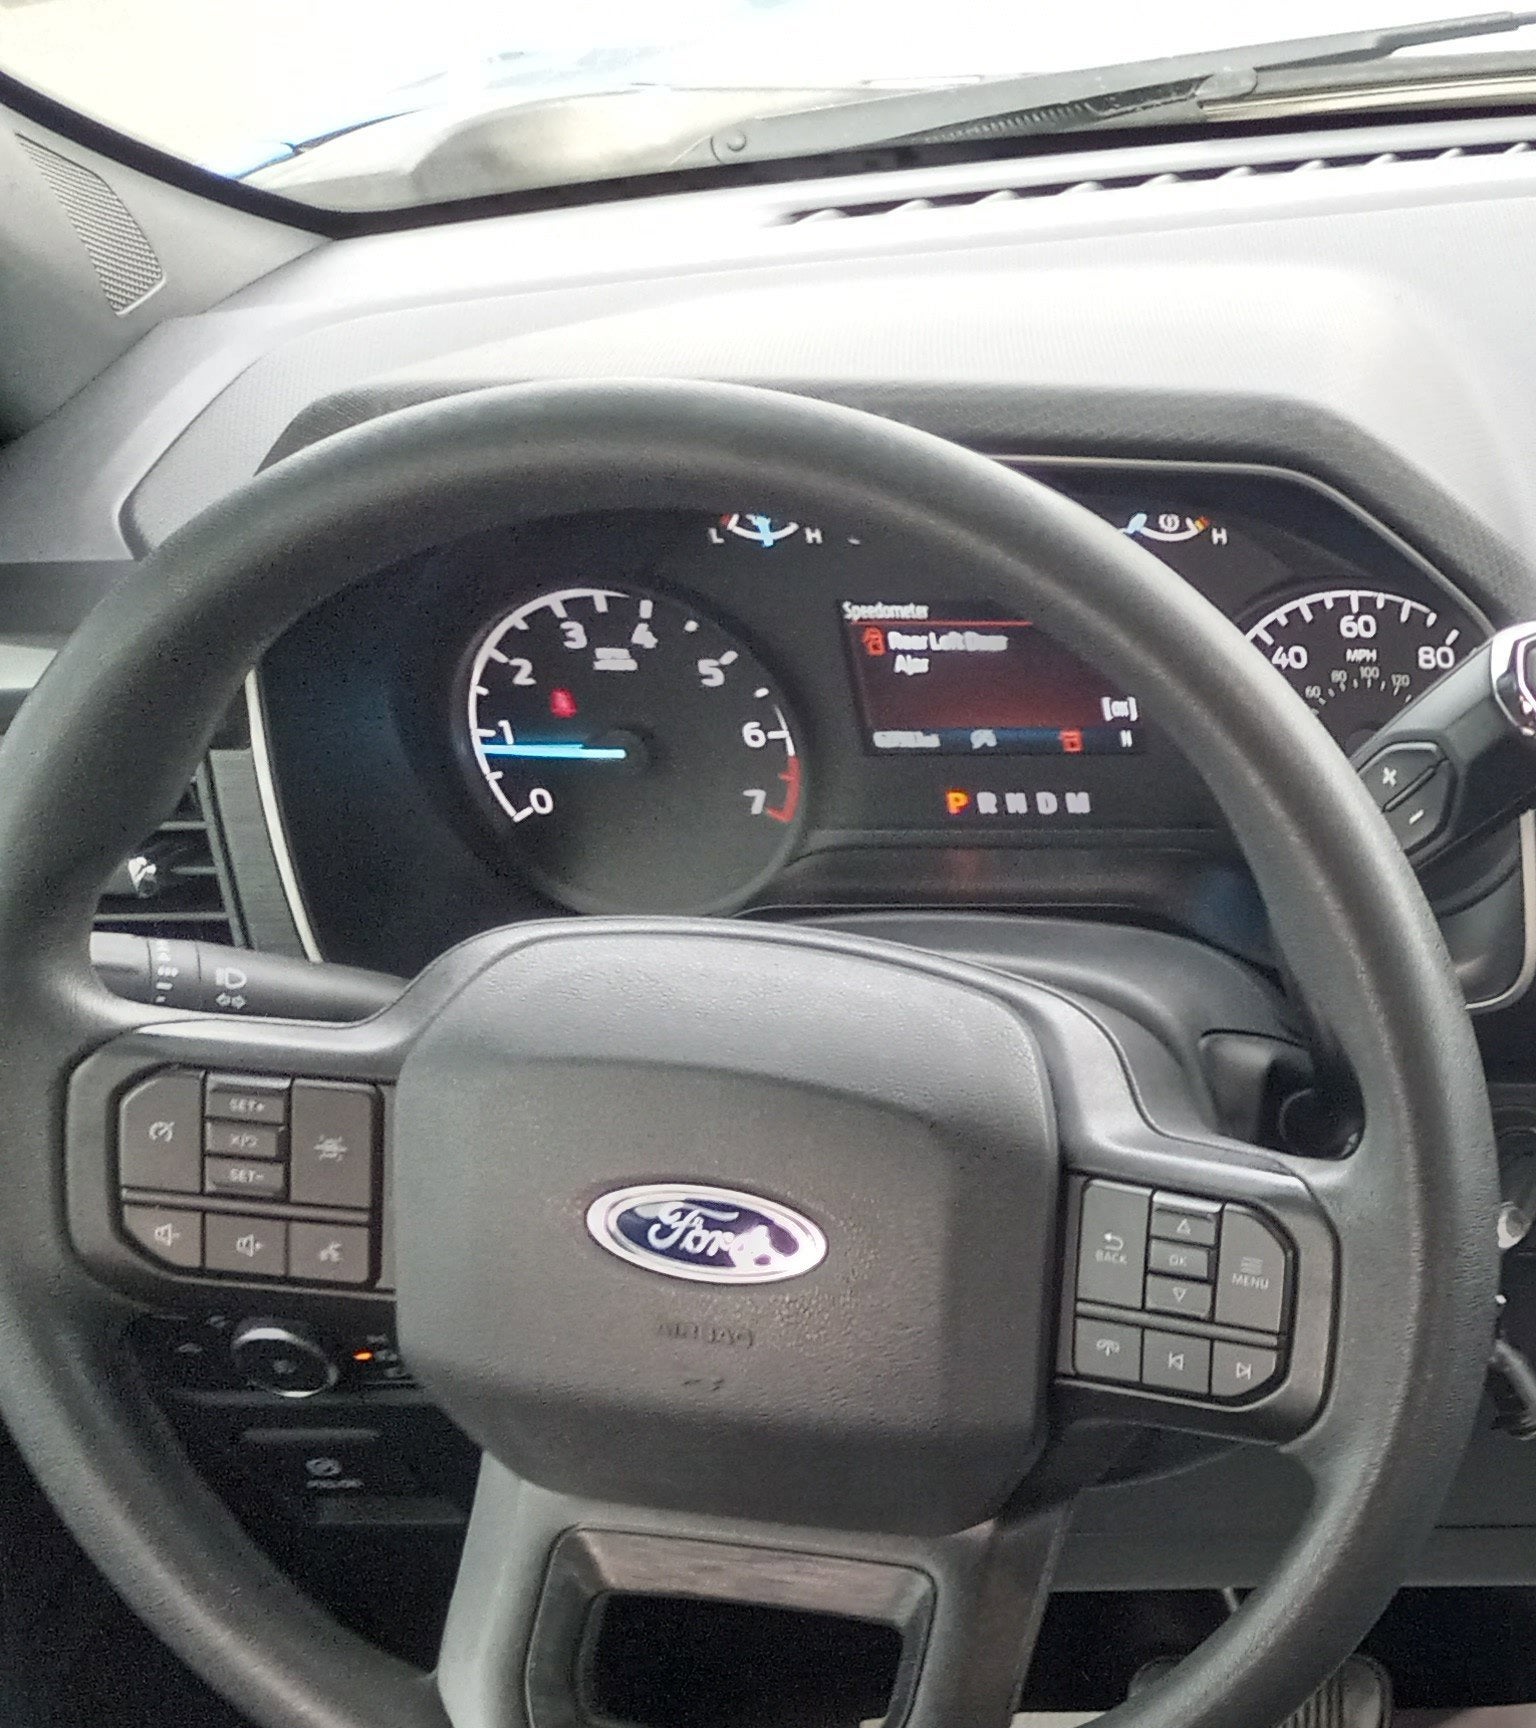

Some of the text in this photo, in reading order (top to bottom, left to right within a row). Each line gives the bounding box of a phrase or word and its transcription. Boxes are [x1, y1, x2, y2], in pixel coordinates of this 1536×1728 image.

[805, 527, 823, 545] H
[1211, 528, 1228, 545] H
[841, 600, 930, 621] Speedometer
[560, 621, 588, 650] 3
[631, 622, 659, 649] 4
[1339, 614, 1377, 638] 60
[1271, 645, 1308, 670] 40
[1345, 648, 1377, 663] MPH
[1417, 645, 1455, 670] 80
[508, 658, 537, 686] 2
[697, 658, 726, 687] 5
[498, 719, 514, 745] 1
[742, 721, 767, 748] 6
[529, 787, 554, 815] 0
[742, 788, 767, 815] 7
[946, 790, 971, 815] P
[1231, 1272, 1270, 1290] MENU
